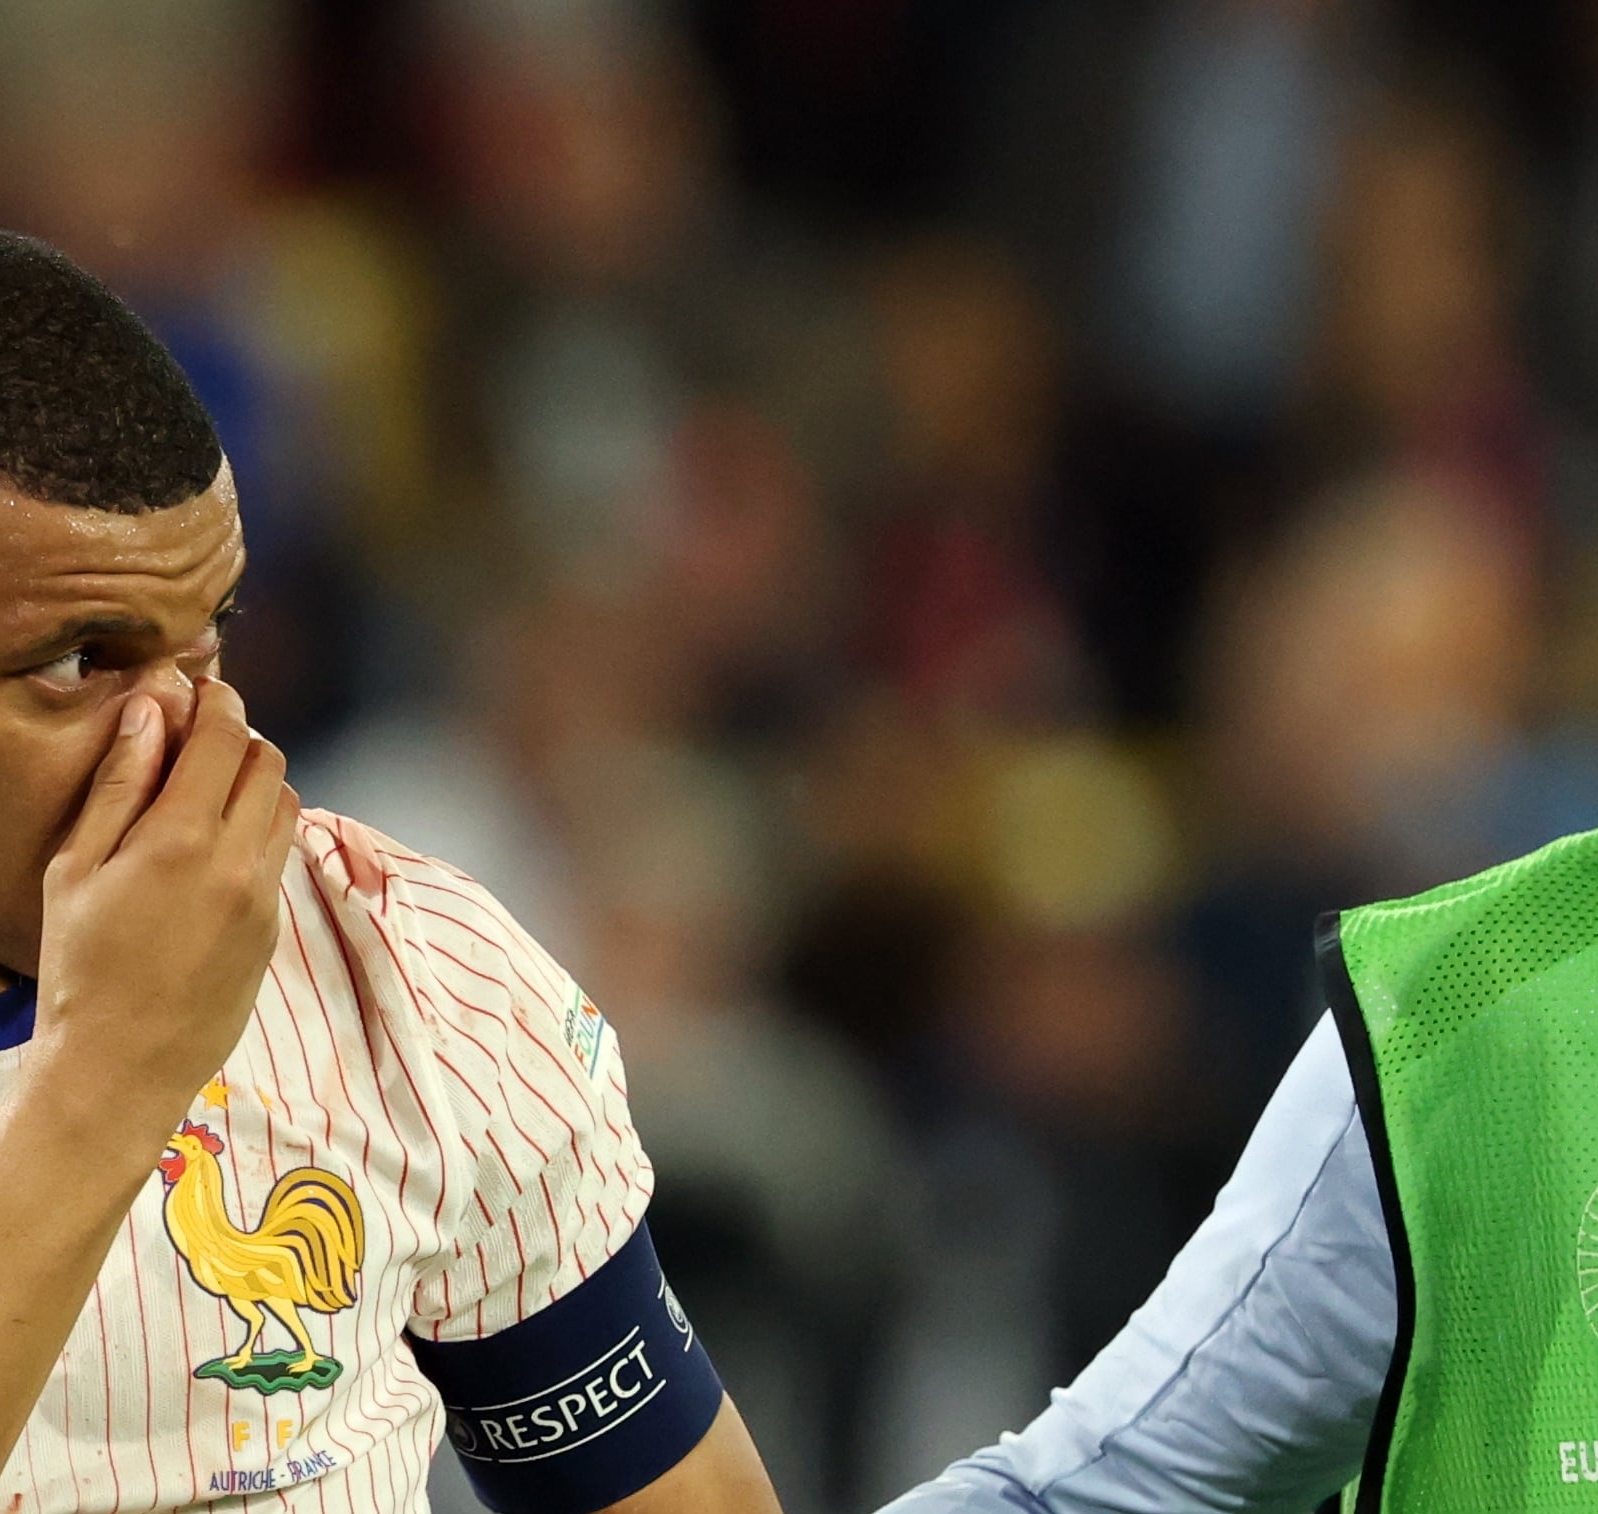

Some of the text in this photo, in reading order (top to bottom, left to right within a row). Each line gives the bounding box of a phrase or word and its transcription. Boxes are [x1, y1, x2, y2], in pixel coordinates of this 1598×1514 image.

[480, 1339, 654, 1451] RESPECT
[209, 1468, 277, 1492] AUTRICHE
[287, 1449, 337, 1483] FRANCE
